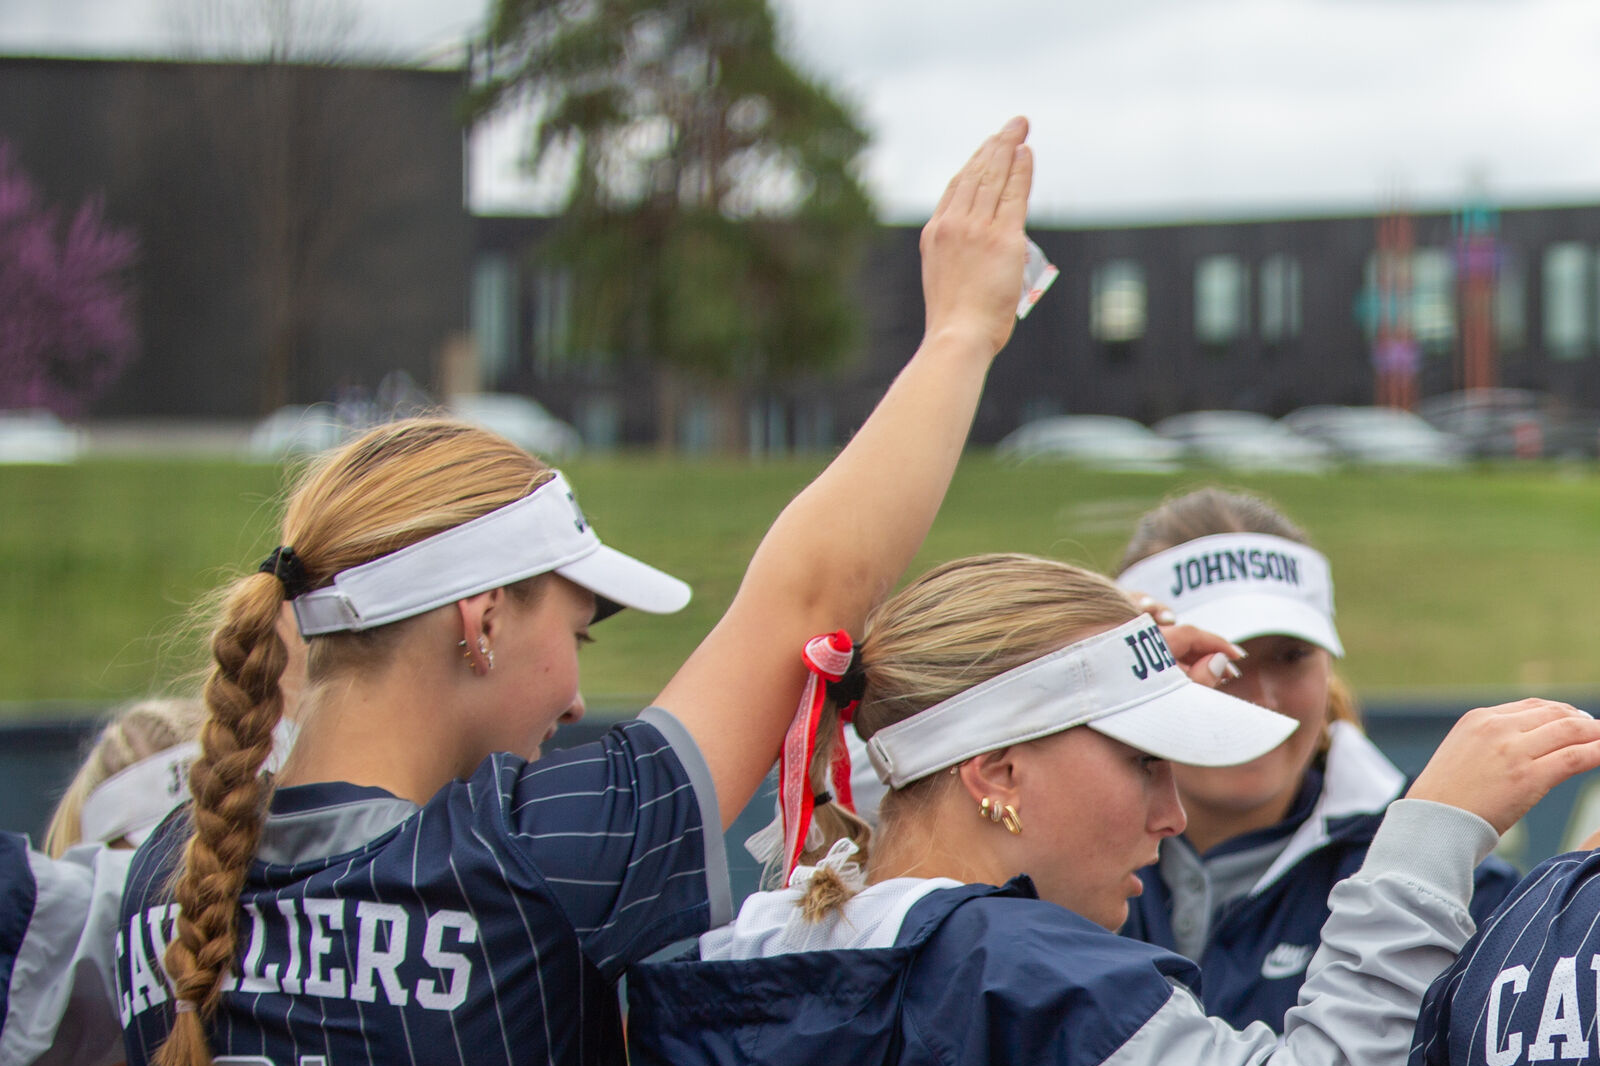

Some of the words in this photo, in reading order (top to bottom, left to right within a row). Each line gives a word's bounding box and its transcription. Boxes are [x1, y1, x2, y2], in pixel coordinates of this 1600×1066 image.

[1170, 547, 1300, 597] JOHNSON
[1123, 623, 1178, 681] JOH
[115, 898, 479, 1030] CAVLIERS
